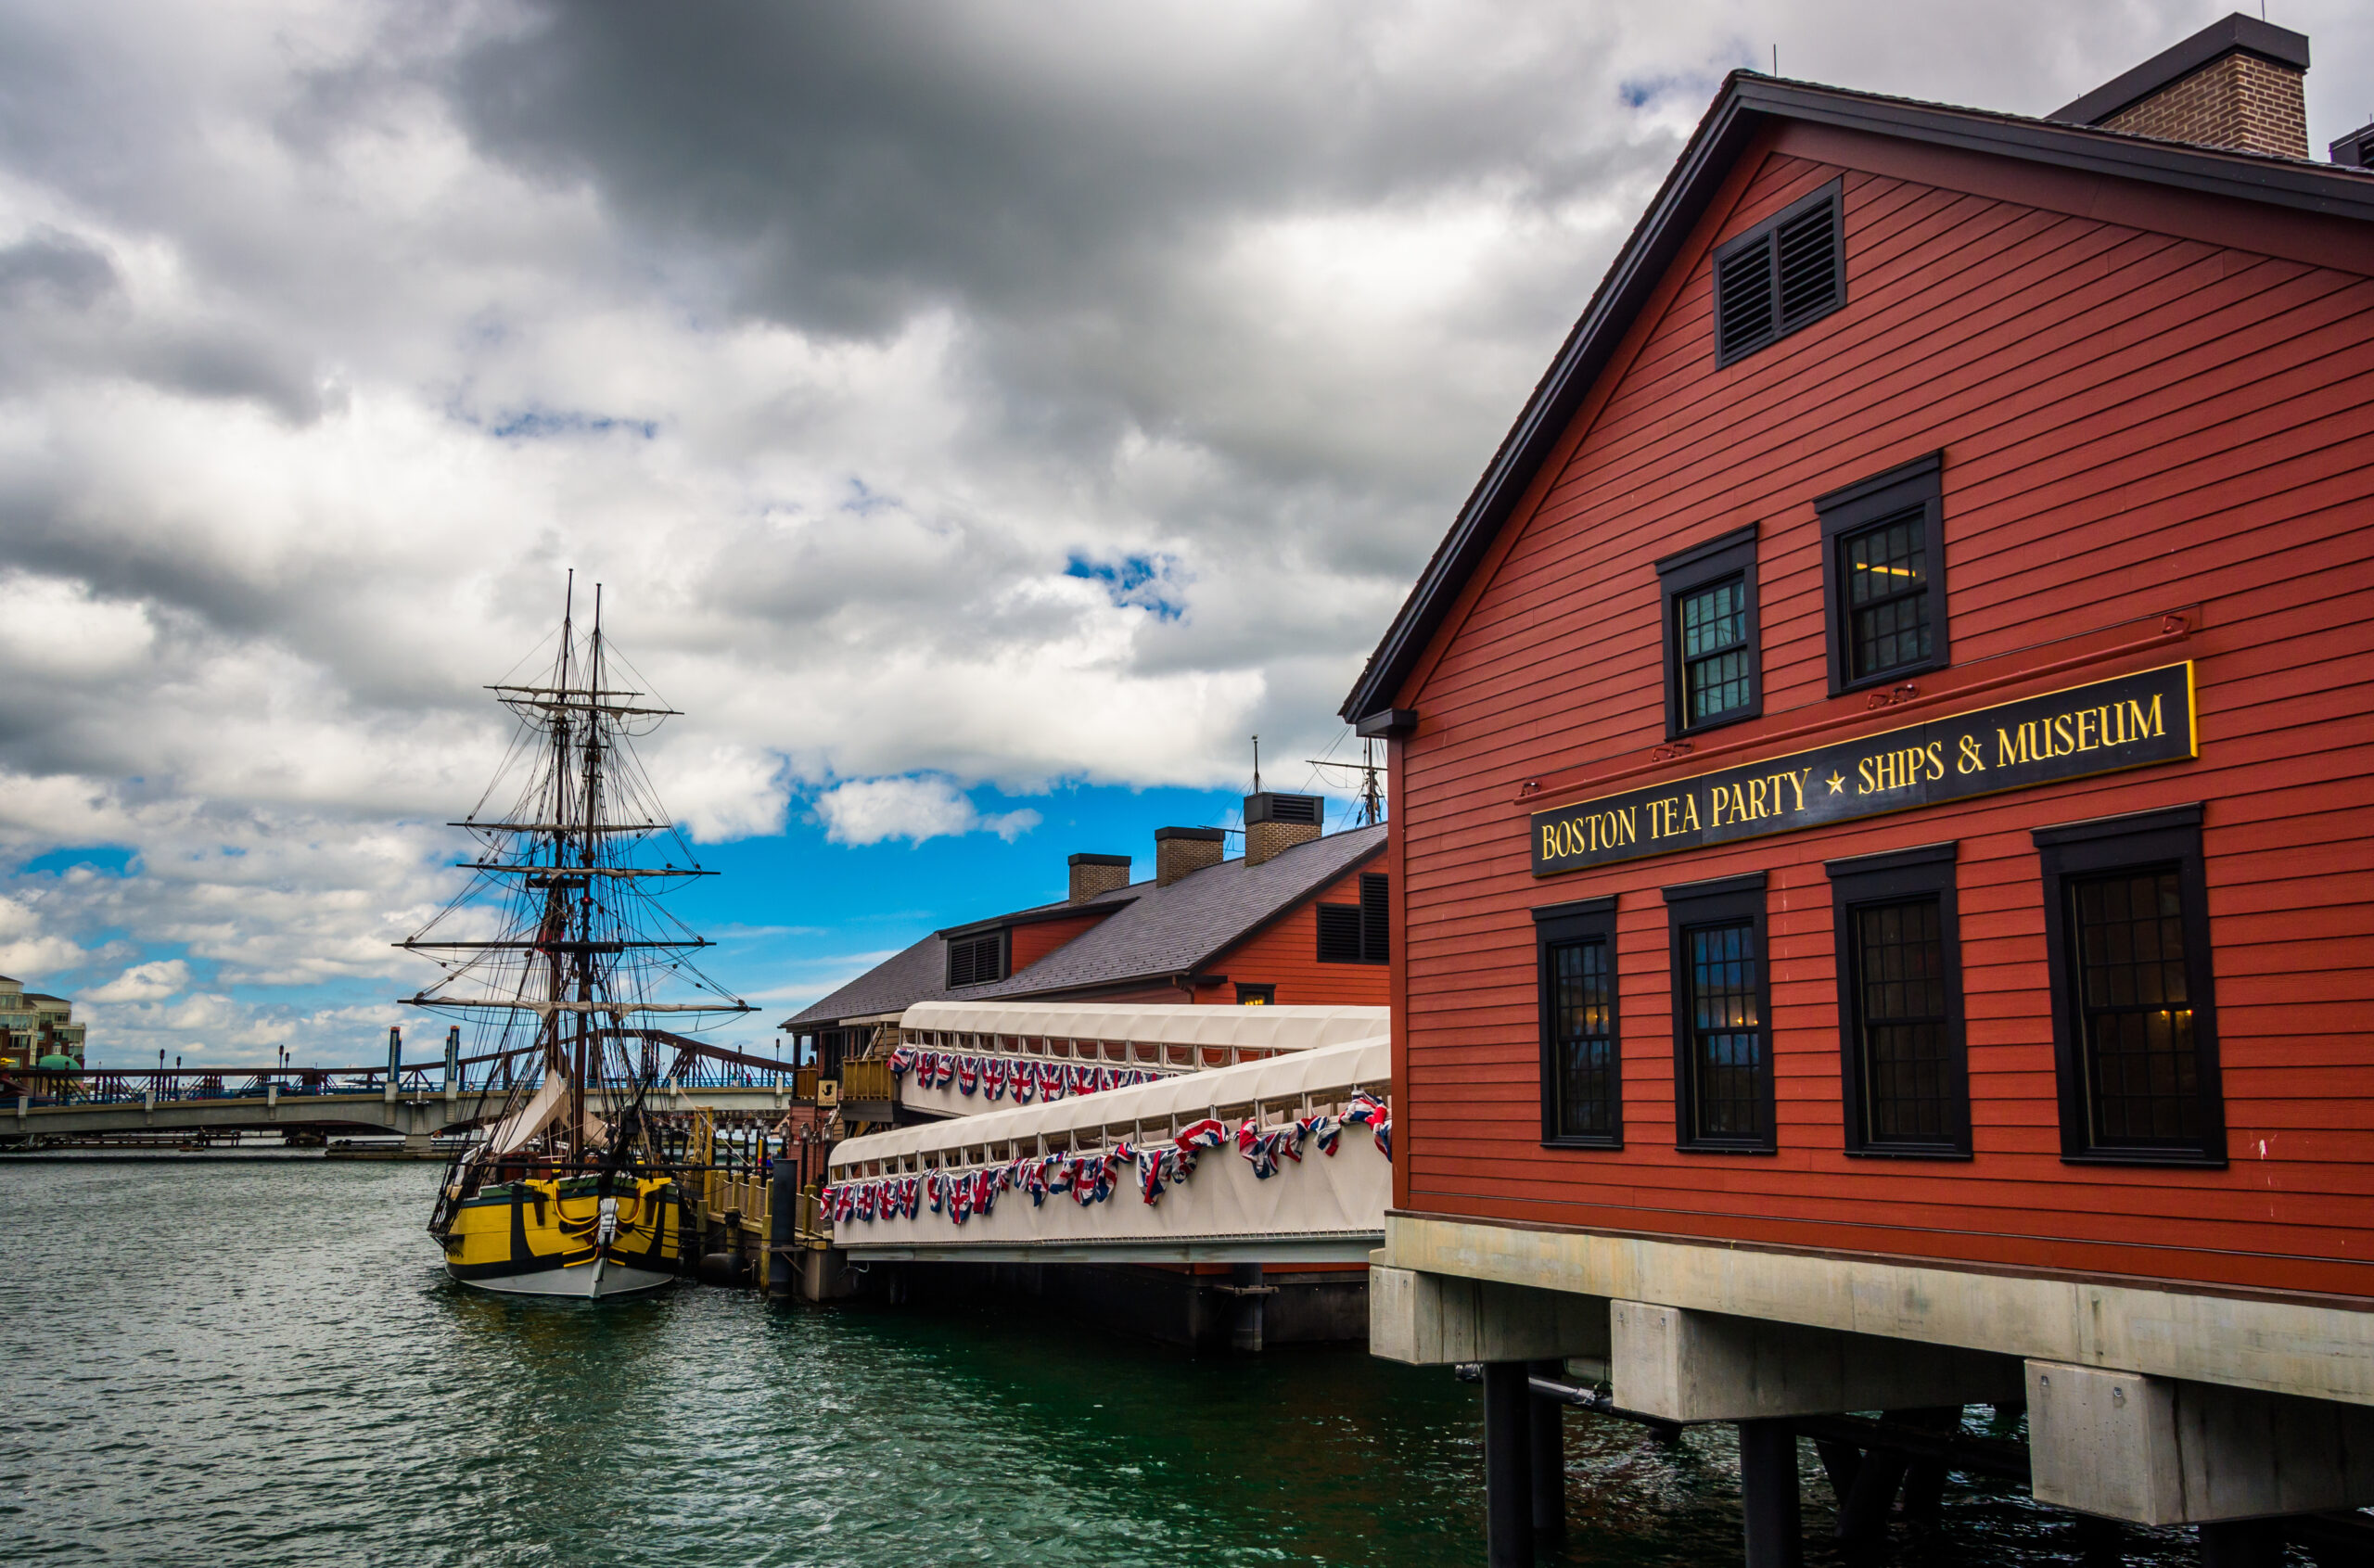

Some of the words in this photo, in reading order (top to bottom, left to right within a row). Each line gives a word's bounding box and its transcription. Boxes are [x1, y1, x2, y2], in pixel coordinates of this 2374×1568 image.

[1541, 806, 1637, 860] BOSTON
[1646, 793, 1702, 839] TEA
[1711, 767, 1813, 828] PARTY
[1857, 740, 1945, 795] SHIPS
[1957, 734, 1986, 775] &
[1996, 693, 2166, 768] MUSEUM
